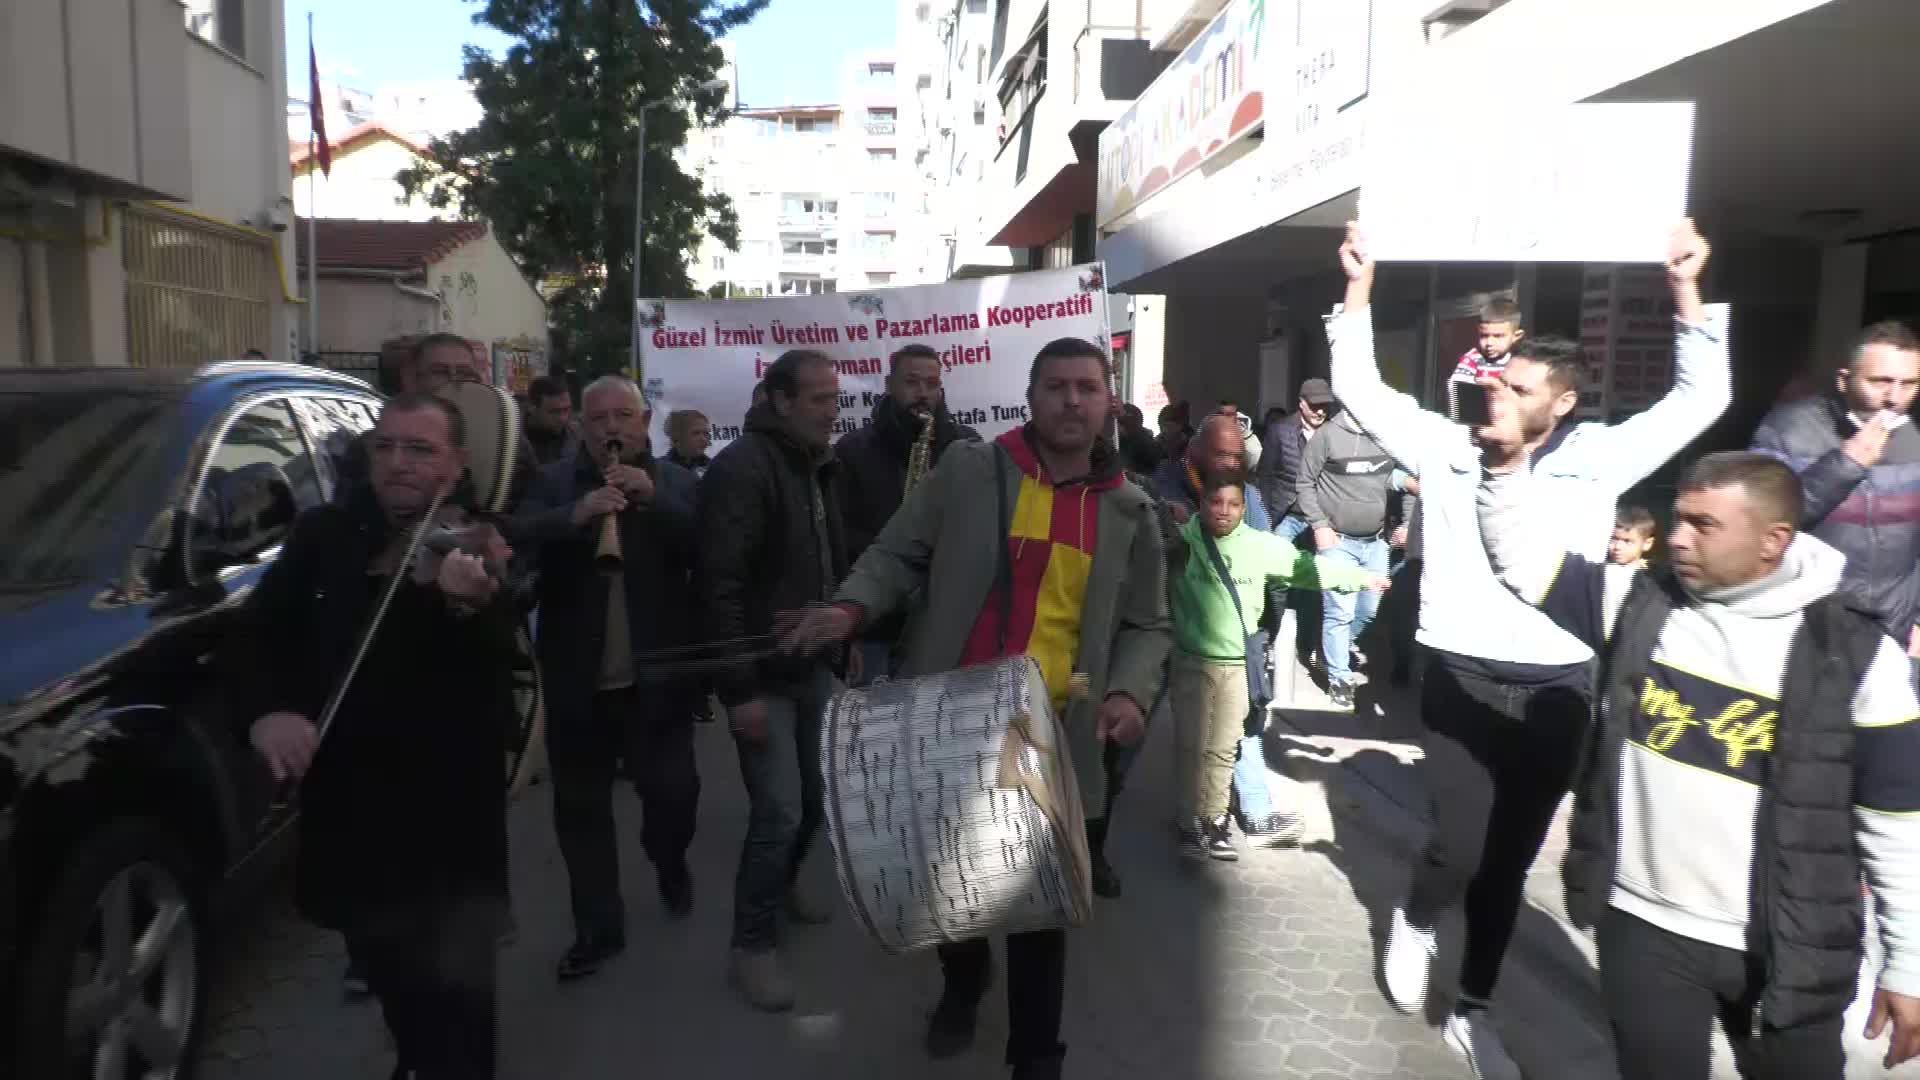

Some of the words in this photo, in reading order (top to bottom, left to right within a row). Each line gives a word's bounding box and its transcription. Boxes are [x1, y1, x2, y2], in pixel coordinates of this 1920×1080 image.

[652, 326, 707, 349] Güzel
[714, 320, 765, 346] İzmir
[770, 319, 839, 345] Üretim
[845, 323, 869, 342] ve
[876, 311, 980, 339] Pazarlama
[987, 292, 1093, 328] Kooperatifi
[832, 357, 882, 376] oman
[990, 404, 1027, 427] Tunç
